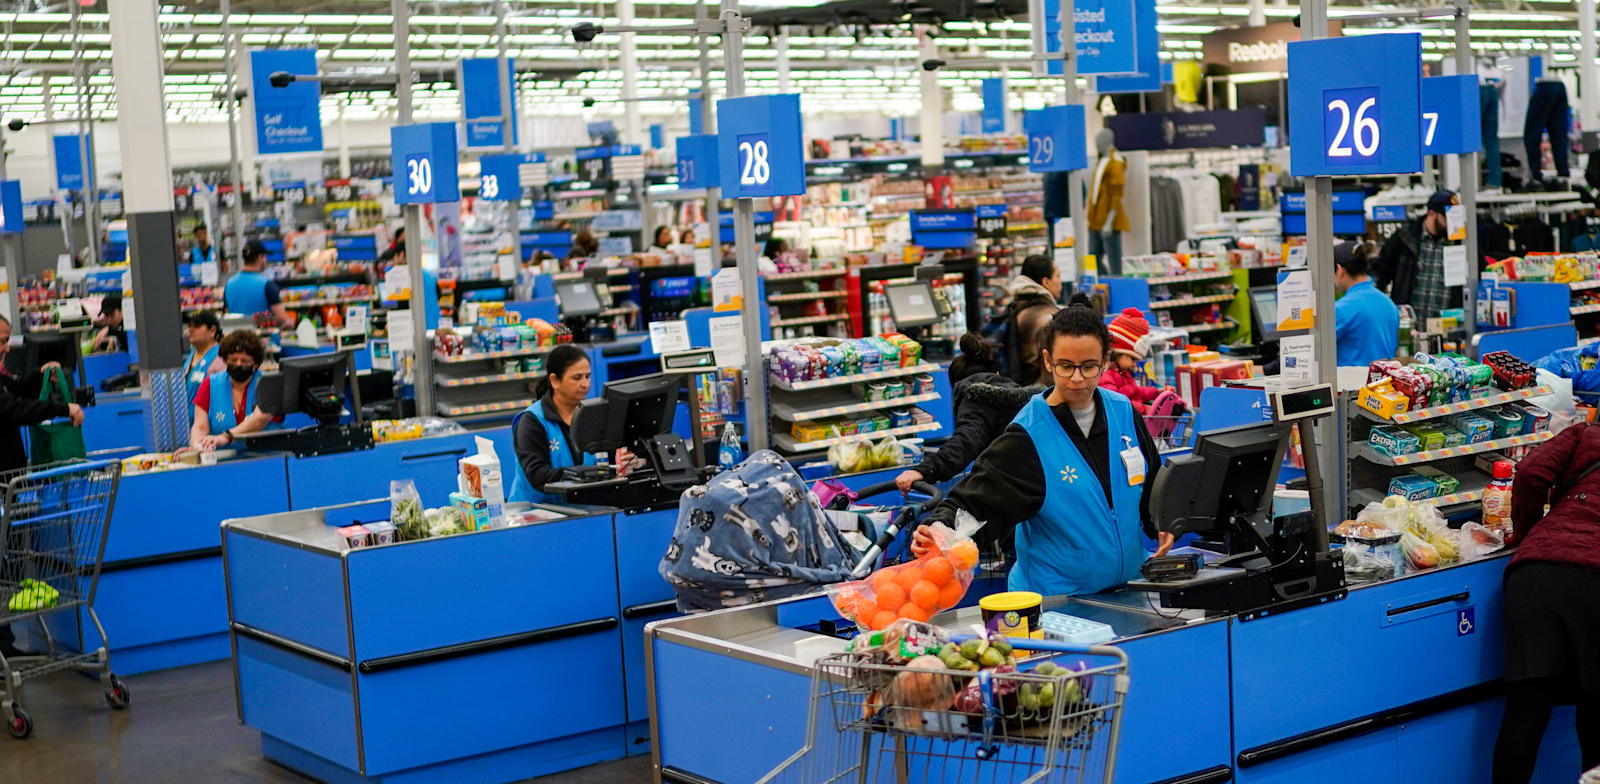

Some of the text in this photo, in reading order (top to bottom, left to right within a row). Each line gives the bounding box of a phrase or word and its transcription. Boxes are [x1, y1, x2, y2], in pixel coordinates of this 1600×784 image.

[1328, 97, 1380, 157] 26
[1422, 112, 1439, 147] 7
[738, 140, 771, 185] 28
[1032, 136, 1054, 164] 29
[407, 158, 431, 194] 30
[680, 160, 695, 182] 31
[482, 174, 499, 198] 33
[1367, 395, 1381, 405] Juicy
[1371, 433, 1395, 446] Extra
[1391, 486, 1407, 496] Extra
